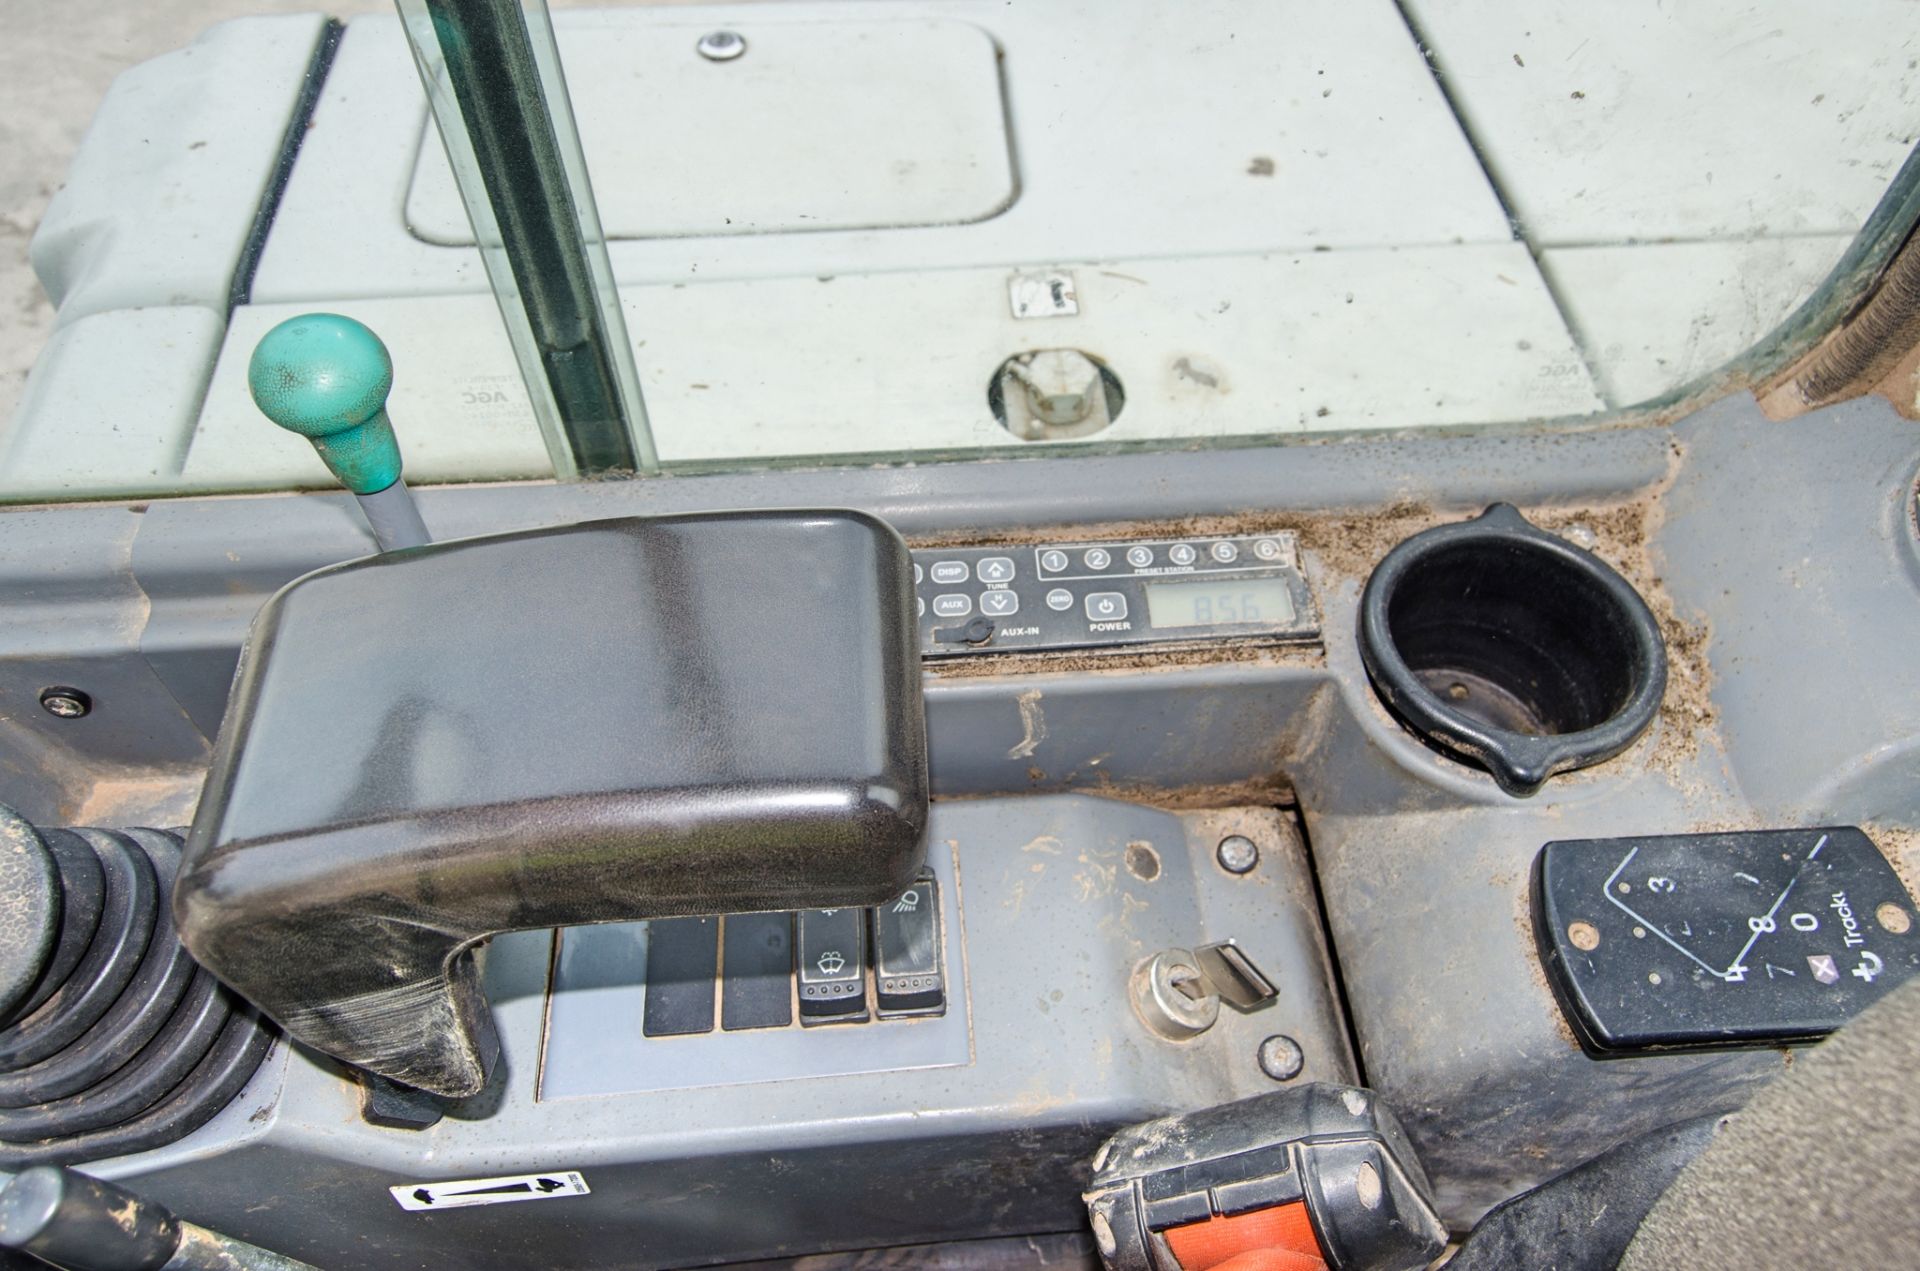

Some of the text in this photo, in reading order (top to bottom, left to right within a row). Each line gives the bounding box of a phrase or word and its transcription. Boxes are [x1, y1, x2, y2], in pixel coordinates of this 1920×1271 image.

[937, 567, 962, 577] DISP
[986, 582, 1009, 591] TUNE
[941, 601, 963, 609] AUX
[1000, 627, 1040, 637] AUX-IN
[1089, 621, 1132, 633] POWER
[1647, 876, 1676, 892] 3
[1747, 915, 1777, 933] 8
[1724, 965, 1749, 982] 4
